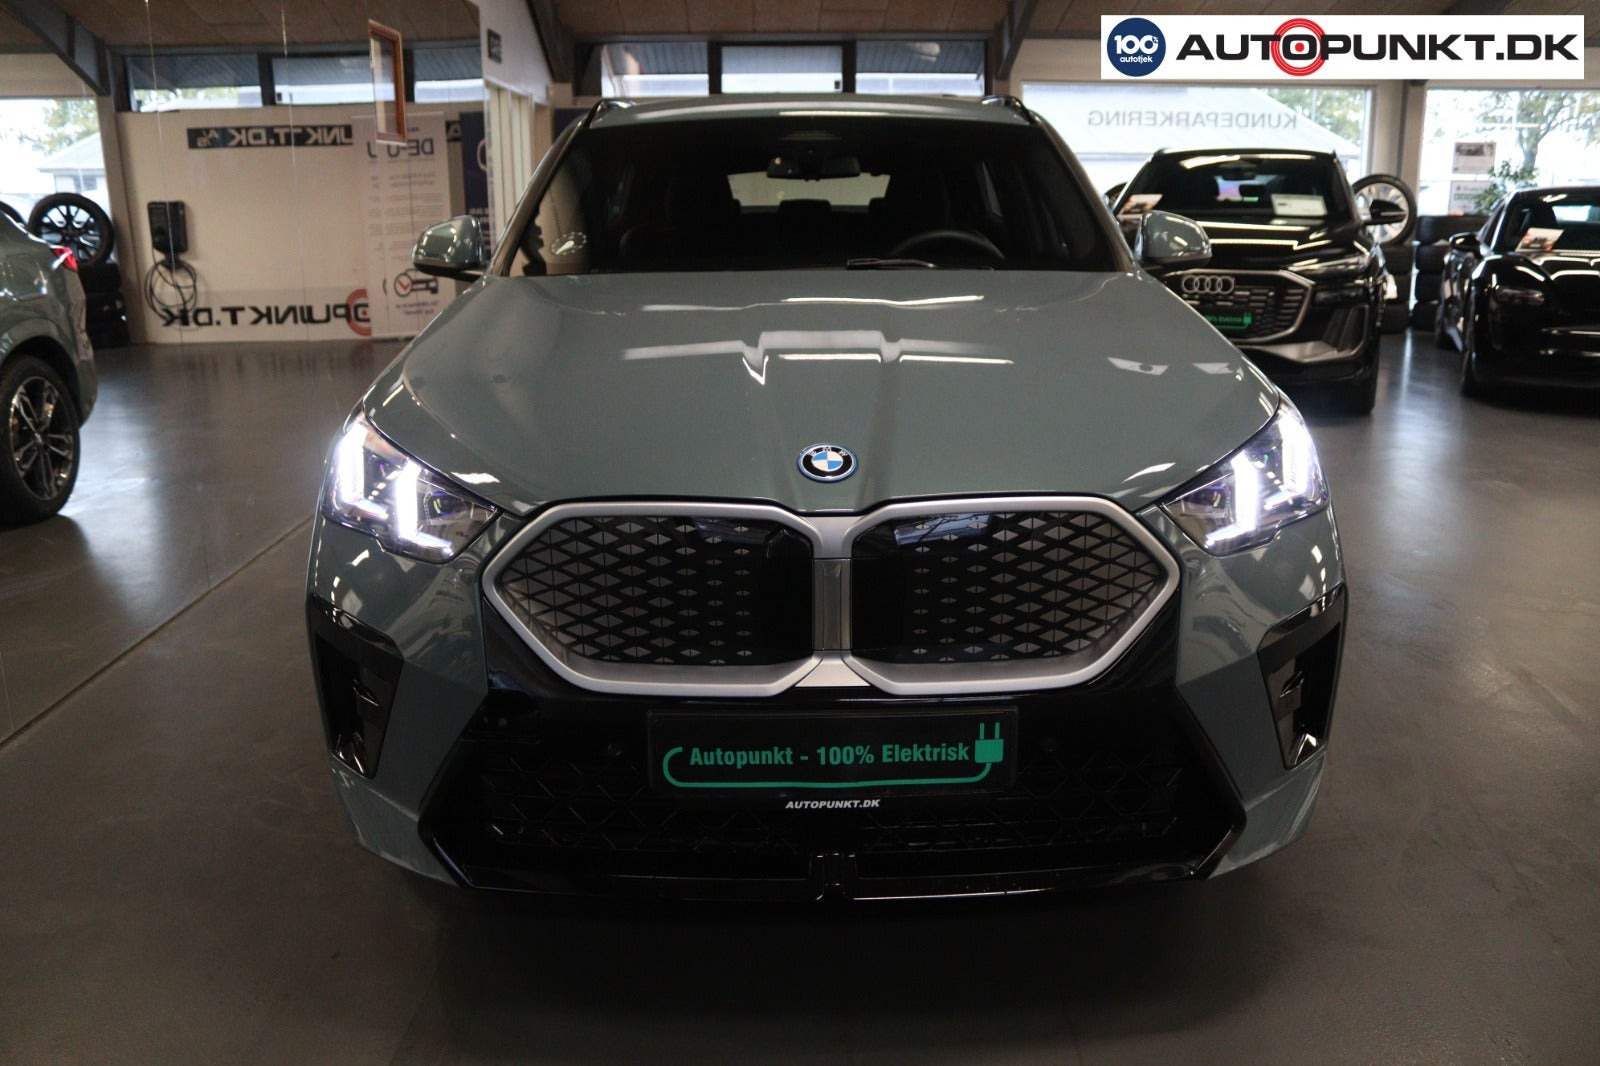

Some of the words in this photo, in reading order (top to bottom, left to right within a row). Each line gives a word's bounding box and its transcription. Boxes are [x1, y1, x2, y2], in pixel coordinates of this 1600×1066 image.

[689, 745, 795, 770] Autopunkt
[816, 745, 875, 765] 100%
[881, 742, 970, 763] Elektrisk
[785, 799, 881, 810] AUTOPUNKT.DK
